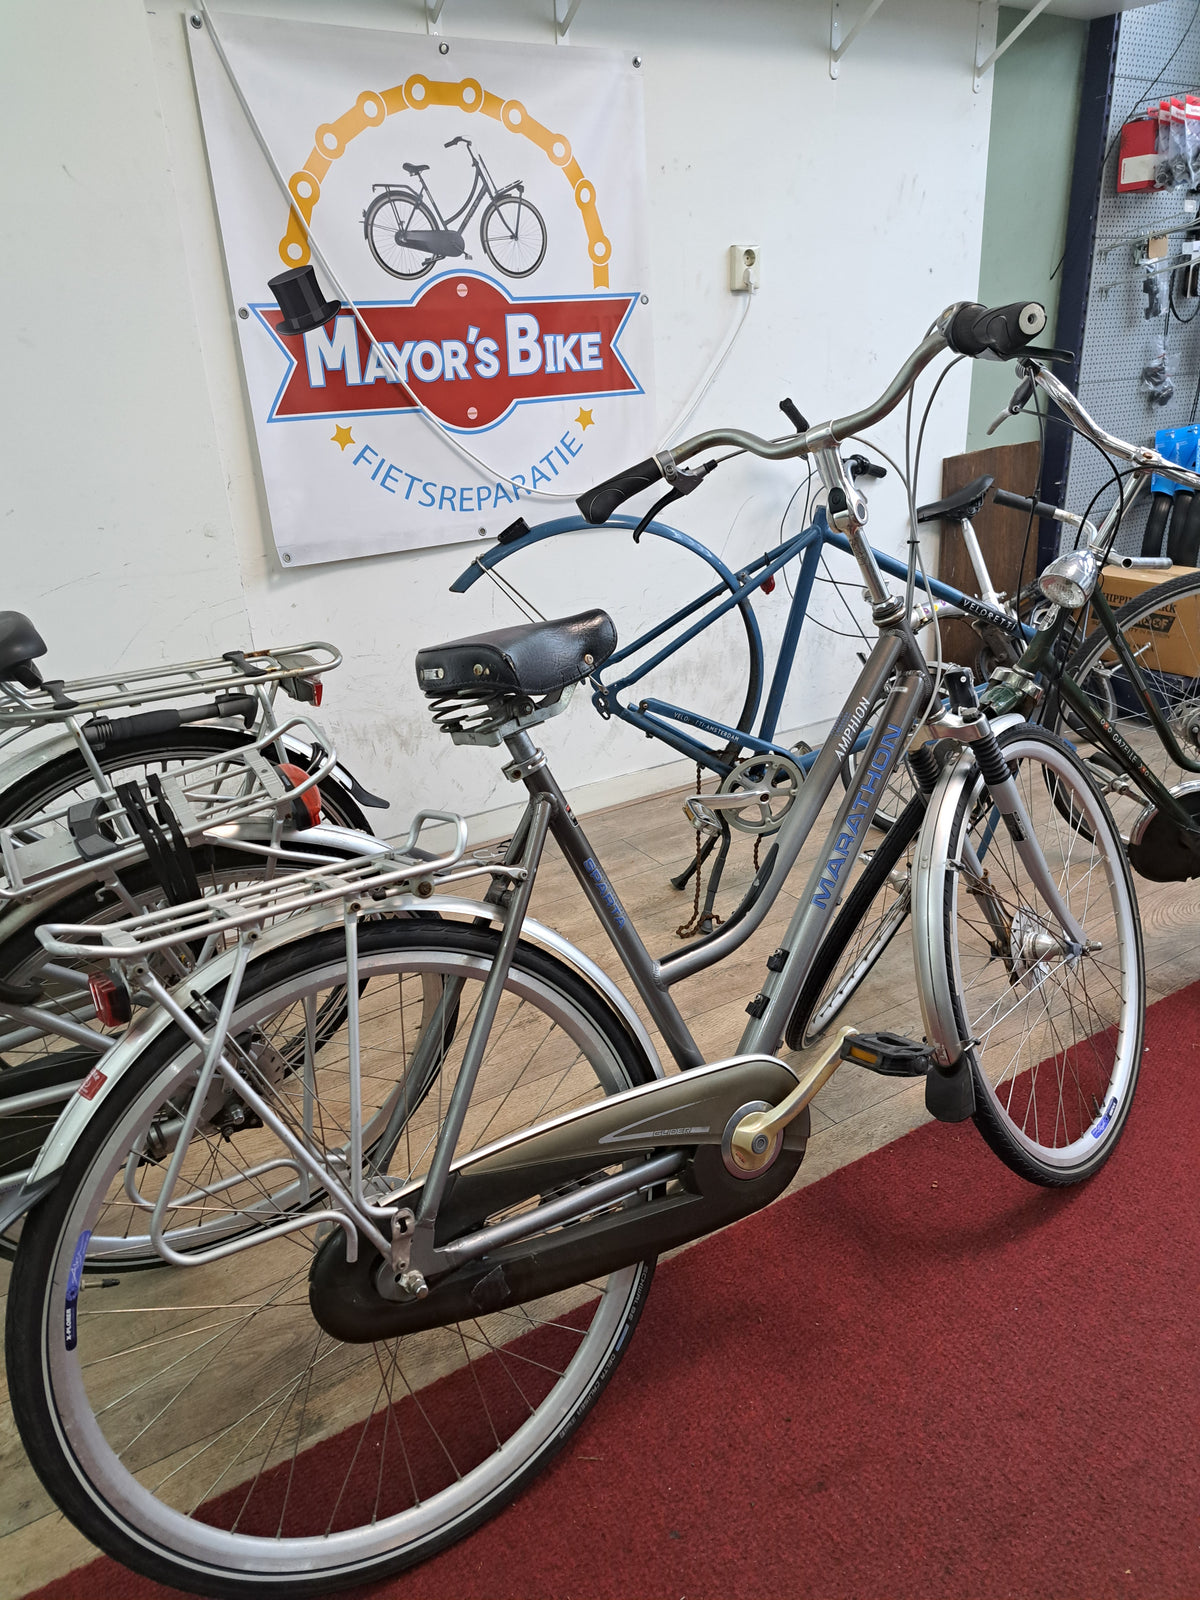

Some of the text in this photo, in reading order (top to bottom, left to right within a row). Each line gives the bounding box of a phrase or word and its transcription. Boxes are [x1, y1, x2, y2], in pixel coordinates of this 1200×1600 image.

[302, 312, 604, 389] MAYOR'S BIKE
[352, 430, 584, 513] FIETSREPARATIE
[963, 599, 1017, 631] VELORETTI
[834, 696, 870, 761] AMPHION
[1112, 733, 1138, 763] GAZELLE
[811, 724, 902, 909] MARATHON
[583, 857, 625, 929] SPARTA
[628, 1265, 649, 1321] SCHWALBE
